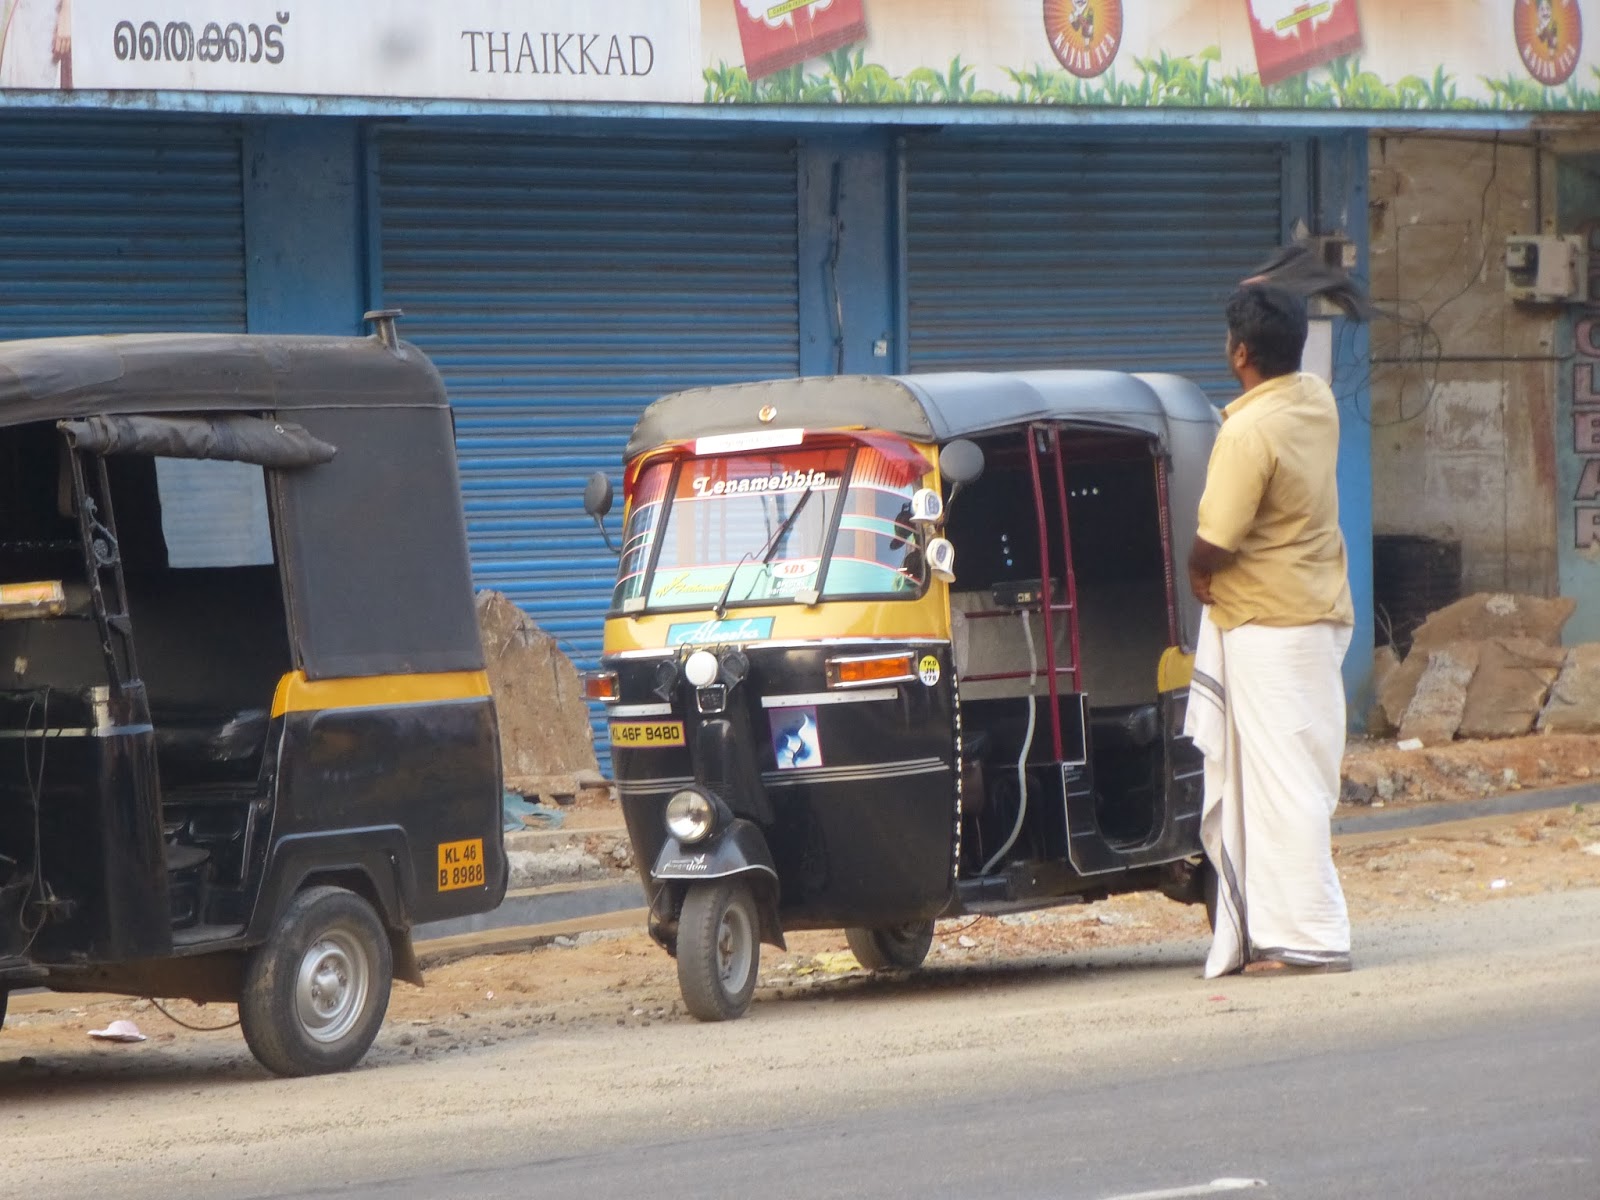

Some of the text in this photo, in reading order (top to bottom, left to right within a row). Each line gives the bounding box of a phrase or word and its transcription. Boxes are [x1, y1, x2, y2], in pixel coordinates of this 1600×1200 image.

[113, 11, 290, 64] തൈക്കാട്
[461, 31, 654, 76] THAIKKAD
[622, 727, 641, 741] 46F
[645, 726, 680, 740] 9480
[445, 844, 477, 864] KL 46
[440, 864, 483, 887] B 8988
